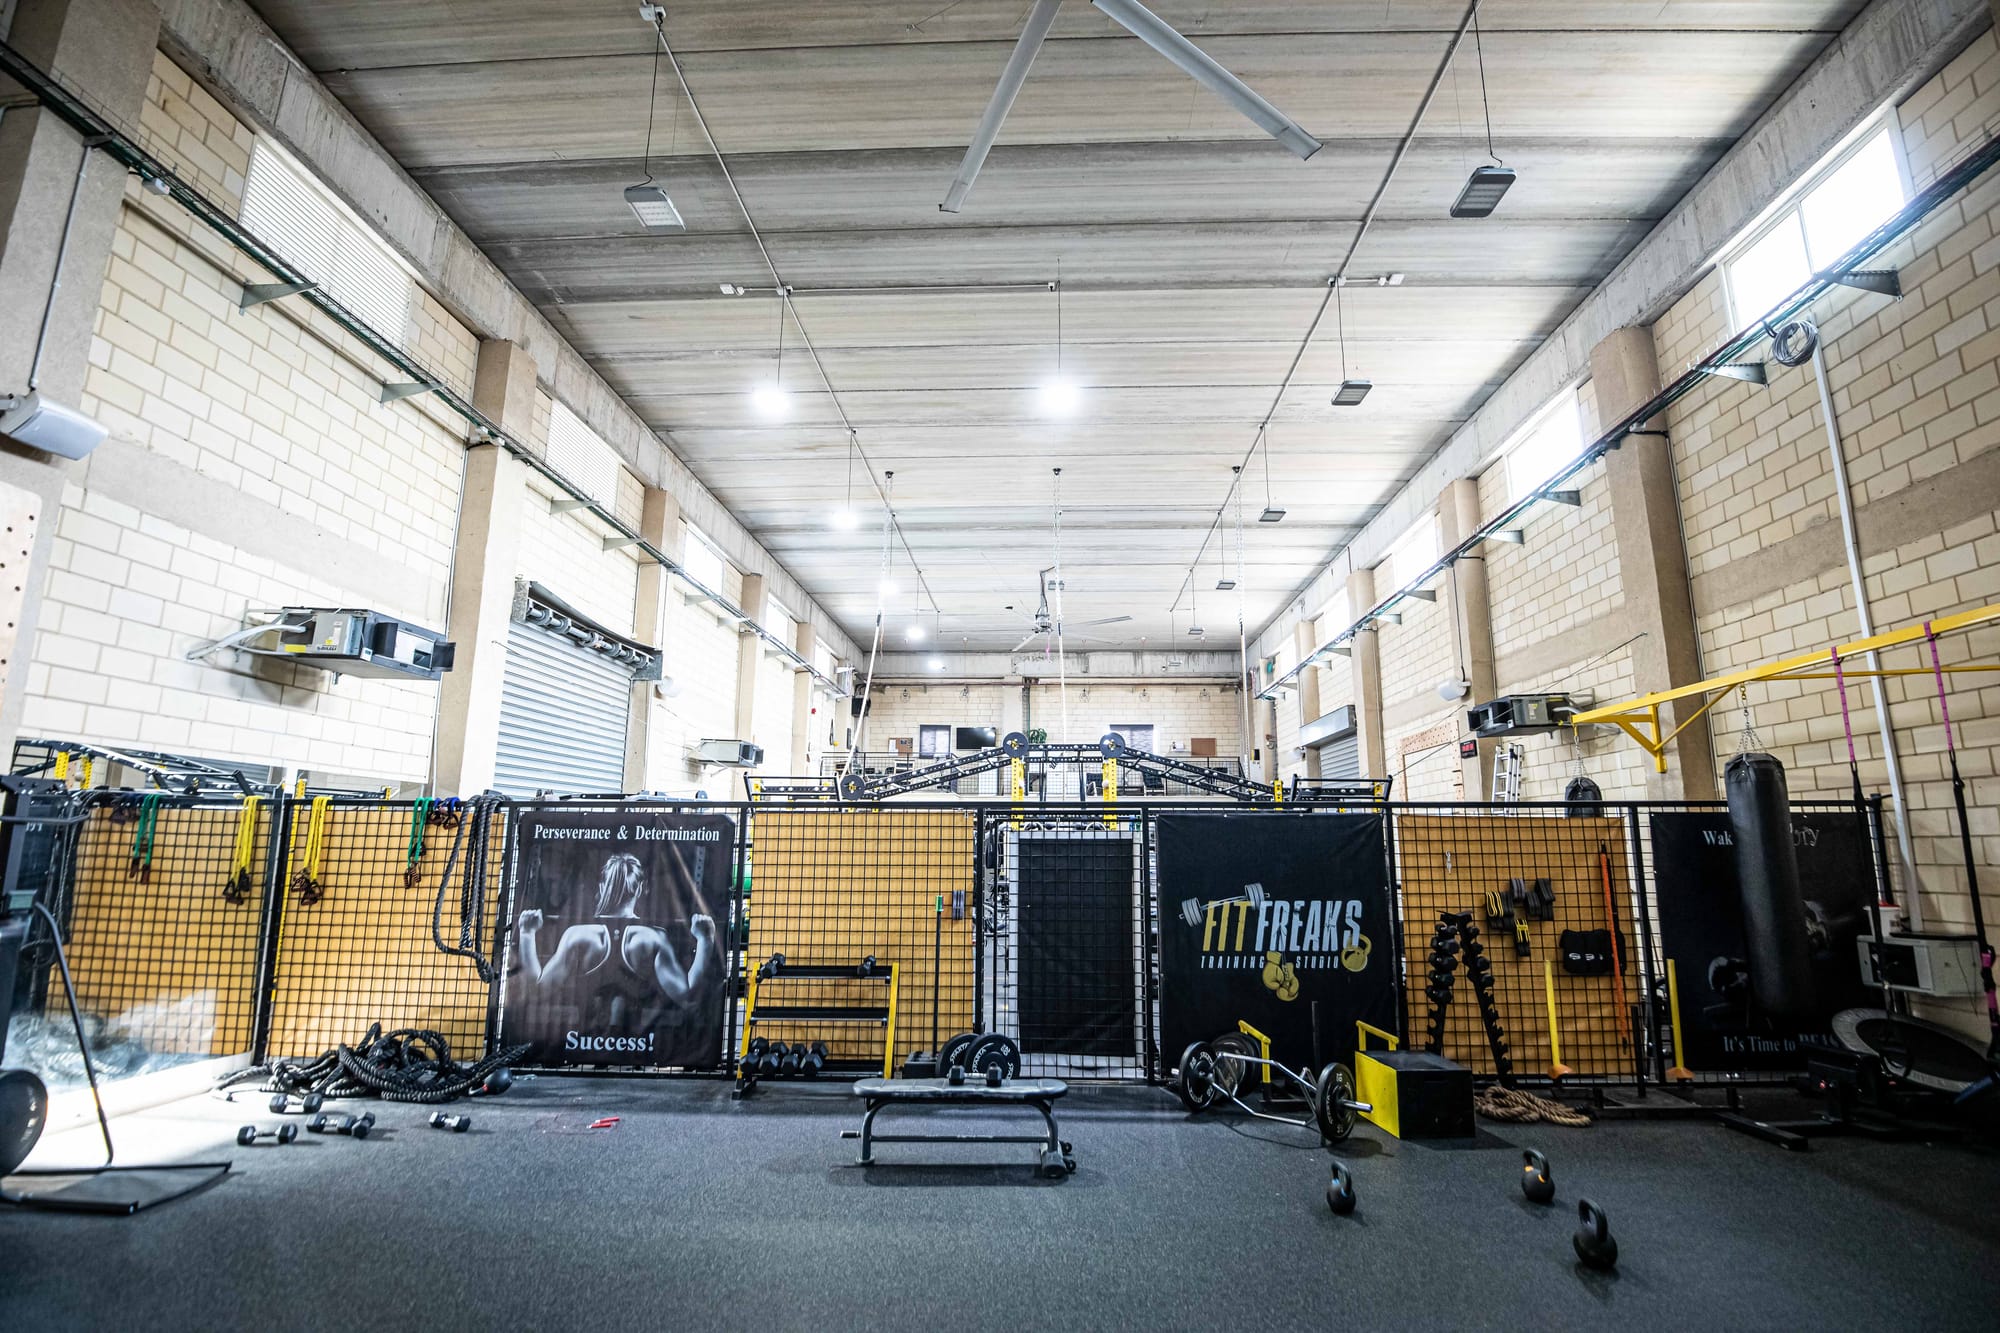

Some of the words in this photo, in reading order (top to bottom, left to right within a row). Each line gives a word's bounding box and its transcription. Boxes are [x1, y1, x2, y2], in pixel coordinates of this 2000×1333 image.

[534, 824, 611, 840] Perseverance
[617, 825, 628, 841] &
[635, 825, 720, 842] Determination
[1702, 830, 1733, 846] Wak
[1202, 900, 1252, 952] FIT
[1255, 900, 1363, 952] FREAKS
[1201, 956, 1265, 969] TRAINING
[1296, 956, 1339, 969] STUDIO
[565, 1030, 655, 1052] Success!
[1723, 1036, 1745, 1052] It's
[1747, 1036, 1780, 1052] Time
[1784, 1037, 1796, 1052] to
